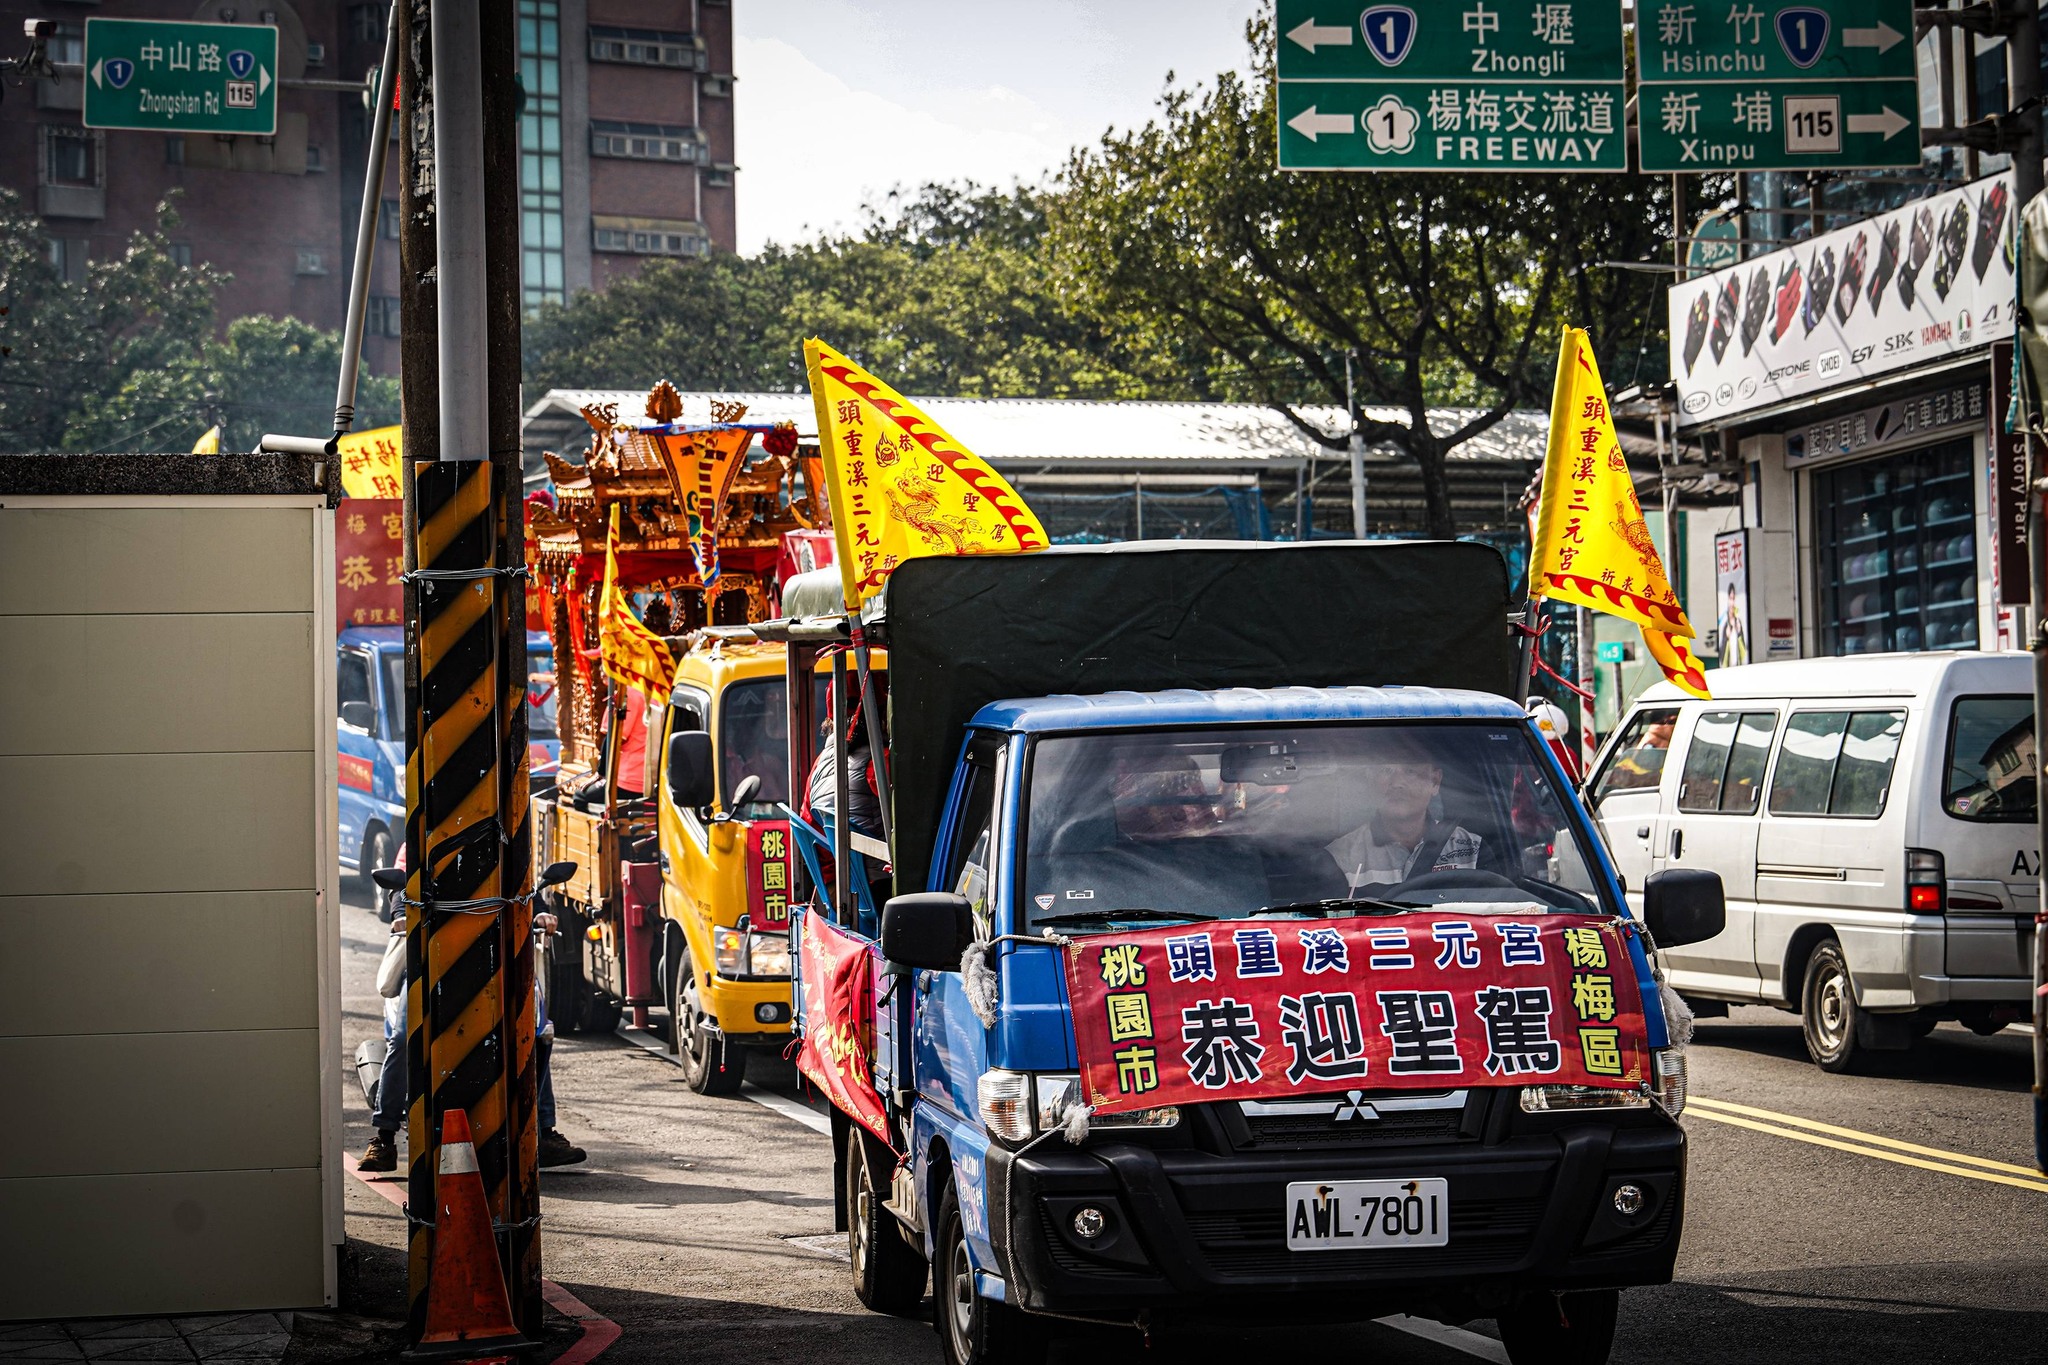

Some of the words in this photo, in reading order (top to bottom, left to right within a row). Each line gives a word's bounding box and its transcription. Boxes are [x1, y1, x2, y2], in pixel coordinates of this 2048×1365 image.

[1379, 17, 1395, 54] 1
[1462, 2, 1575, 45] 中壢
[1658, 4, 1765, 46] 新竹
[1796, 19, 1807, 50] 1
[114, 63, 123, 79] 1
[140, 40, 222, 73] 中山路
[236, 55, 244, 71] 1
[1471, 49, 1566, 77] Zhongli
[1662, 50, 1766, 73] Hsinchu
[139, 88, 200, 119] Zhongshan
[228, 86, 253, 102] 115
[1427, 89, 1615, 134] 楊梅交流道
[1661, 91, 1773, 135] 新埔
[1382, 112, 1395, 140] 1
[1792, 111, 1834, 138] 115
[1436, 137, 1605, 162] FREEWAY
[1680, 139, 1755, 165] Xinpu
[1763, 360, 1811, 383] ASTONE
[1820, 354, 1840, 373] SHOEI
[1884, 330, 1914, 352] SBK
[1921, 320, 1953, 346] YAMAHA
[1903, 385, 1982, 433] 行車記錄器
[1808, 414, 1867, 458] 藍牙耳機
[837, 398, 880, 577] 頭重溪三元宮
[898, 432, 1006, 544] 恭迎聖駕
[1559, 395, 1607, 572] 頭重溪三元宮
[2011, 443, 2027, 494] Story
[2014, 501, 2028, 545] Park
[1717, 539, 1742, 574] 雨衣
[761, 830, 787, 921] 桃園市
[1165, 919, 1546, 985] 頭重溪三元宮
[1099, 942, 1161, 1095] 桃園市
[1563, 926, 1625, 1078] 楊梅區
[1181, 985, 1563, 1091] 恭迎聖駕
